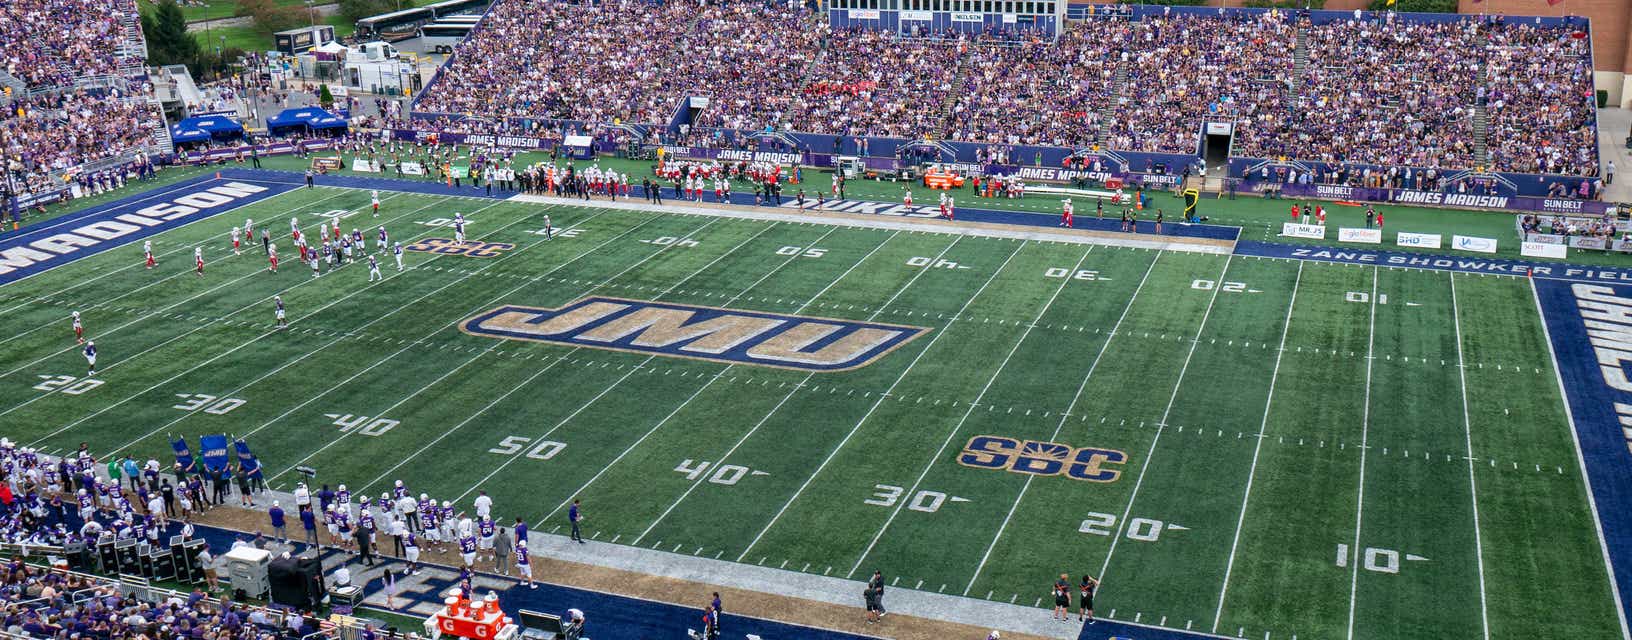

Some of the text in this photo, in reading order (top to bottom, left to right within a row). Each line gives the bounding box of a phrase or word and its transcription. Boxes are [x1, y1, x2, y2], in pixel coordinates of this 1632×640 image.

[464, 134, 540, 148] JAMES MADISON
[717, 149, 802, 163] JAMES MADISON
[1016, 167, 1056, 180] JAMES
[1143, 175, 1176, 184] SUN BELT
[1317, 186, 1353, 195] SUN BELT
[1395, 190, 1508, 208] JAMES MADISON
[1544, 200, 1584, 209] SUN BELT
[0, 181, 269, 275] MADISON
[1291, 249, 1378, 261] ZANE
[1387, 256, 1552, 275] SHOWKER
[470, 298, 915, 369] JMU
[31, 375, 105, 395] 20
[171, 393, 247, 415] 30
[332, 413, 400, 436] 40
[488, 435, 567, 460] 50
[956, 435, 1128, 483] SBC
[673, 458, 750, 485] 40
[863, 483, 947, 513] 30
[1078, 511, 1163, 542] 20
[1335, 543, 1399, 574] 10
[443, 619, 454, 631] G
[475, 625, 487, 637] G
